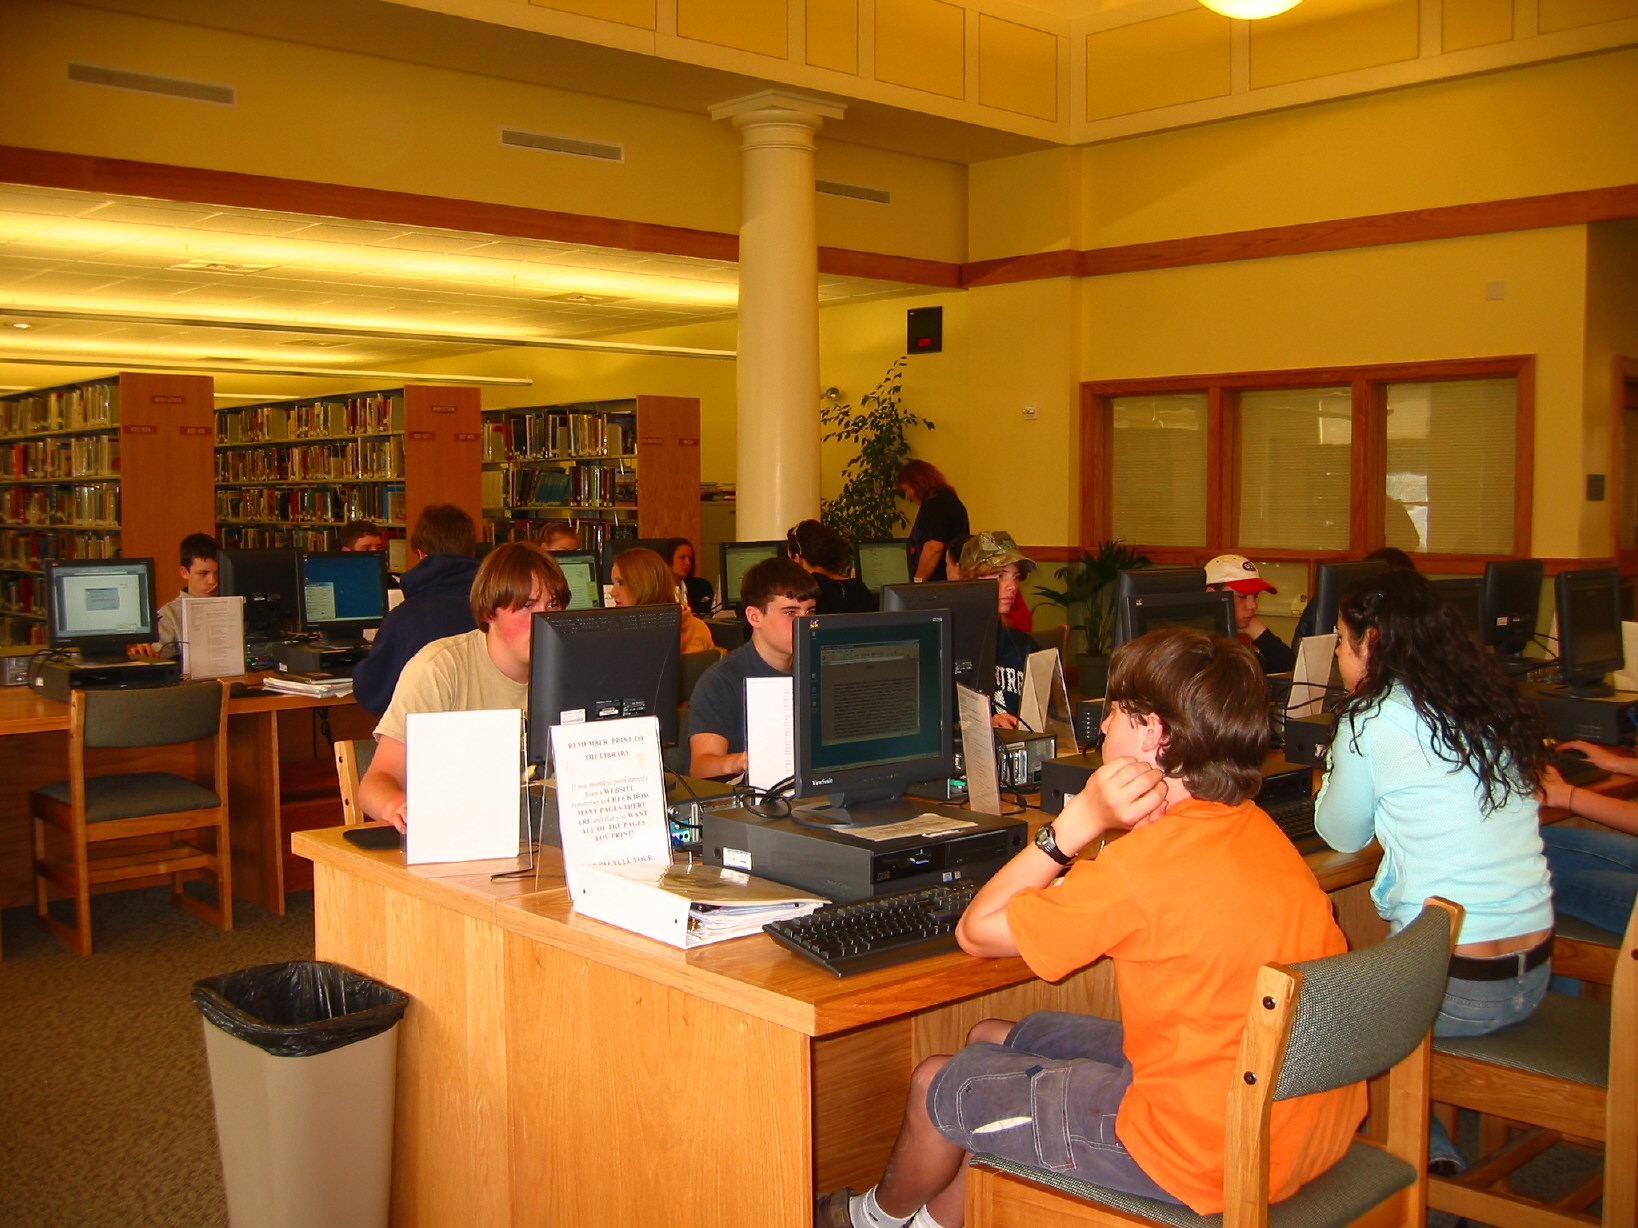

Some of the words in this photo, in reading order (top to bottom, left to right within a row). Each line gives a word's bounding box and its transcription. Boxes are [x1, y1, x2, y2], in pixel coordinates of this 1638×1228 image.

[612, 736, 632, 745] PRINT
[584, 753, 598, 761] THE
[600, 750, 630, 760] LIBRARY
[614, 778, 626, 786] print
[604, 786, 636, 794] WEBSITE
[572, 800, 598, 808] remember
[607, 794, 632, 804] CHECK
[600, 805, 622, 814] PAGES
[624, 802, 646, 810] THERE
[582, 826, 594, 835] ALL
[608, 823, 621, 831] THE
[624, 820, 646, 829] PAGES
[634, 854, 654, 863] YOUR
